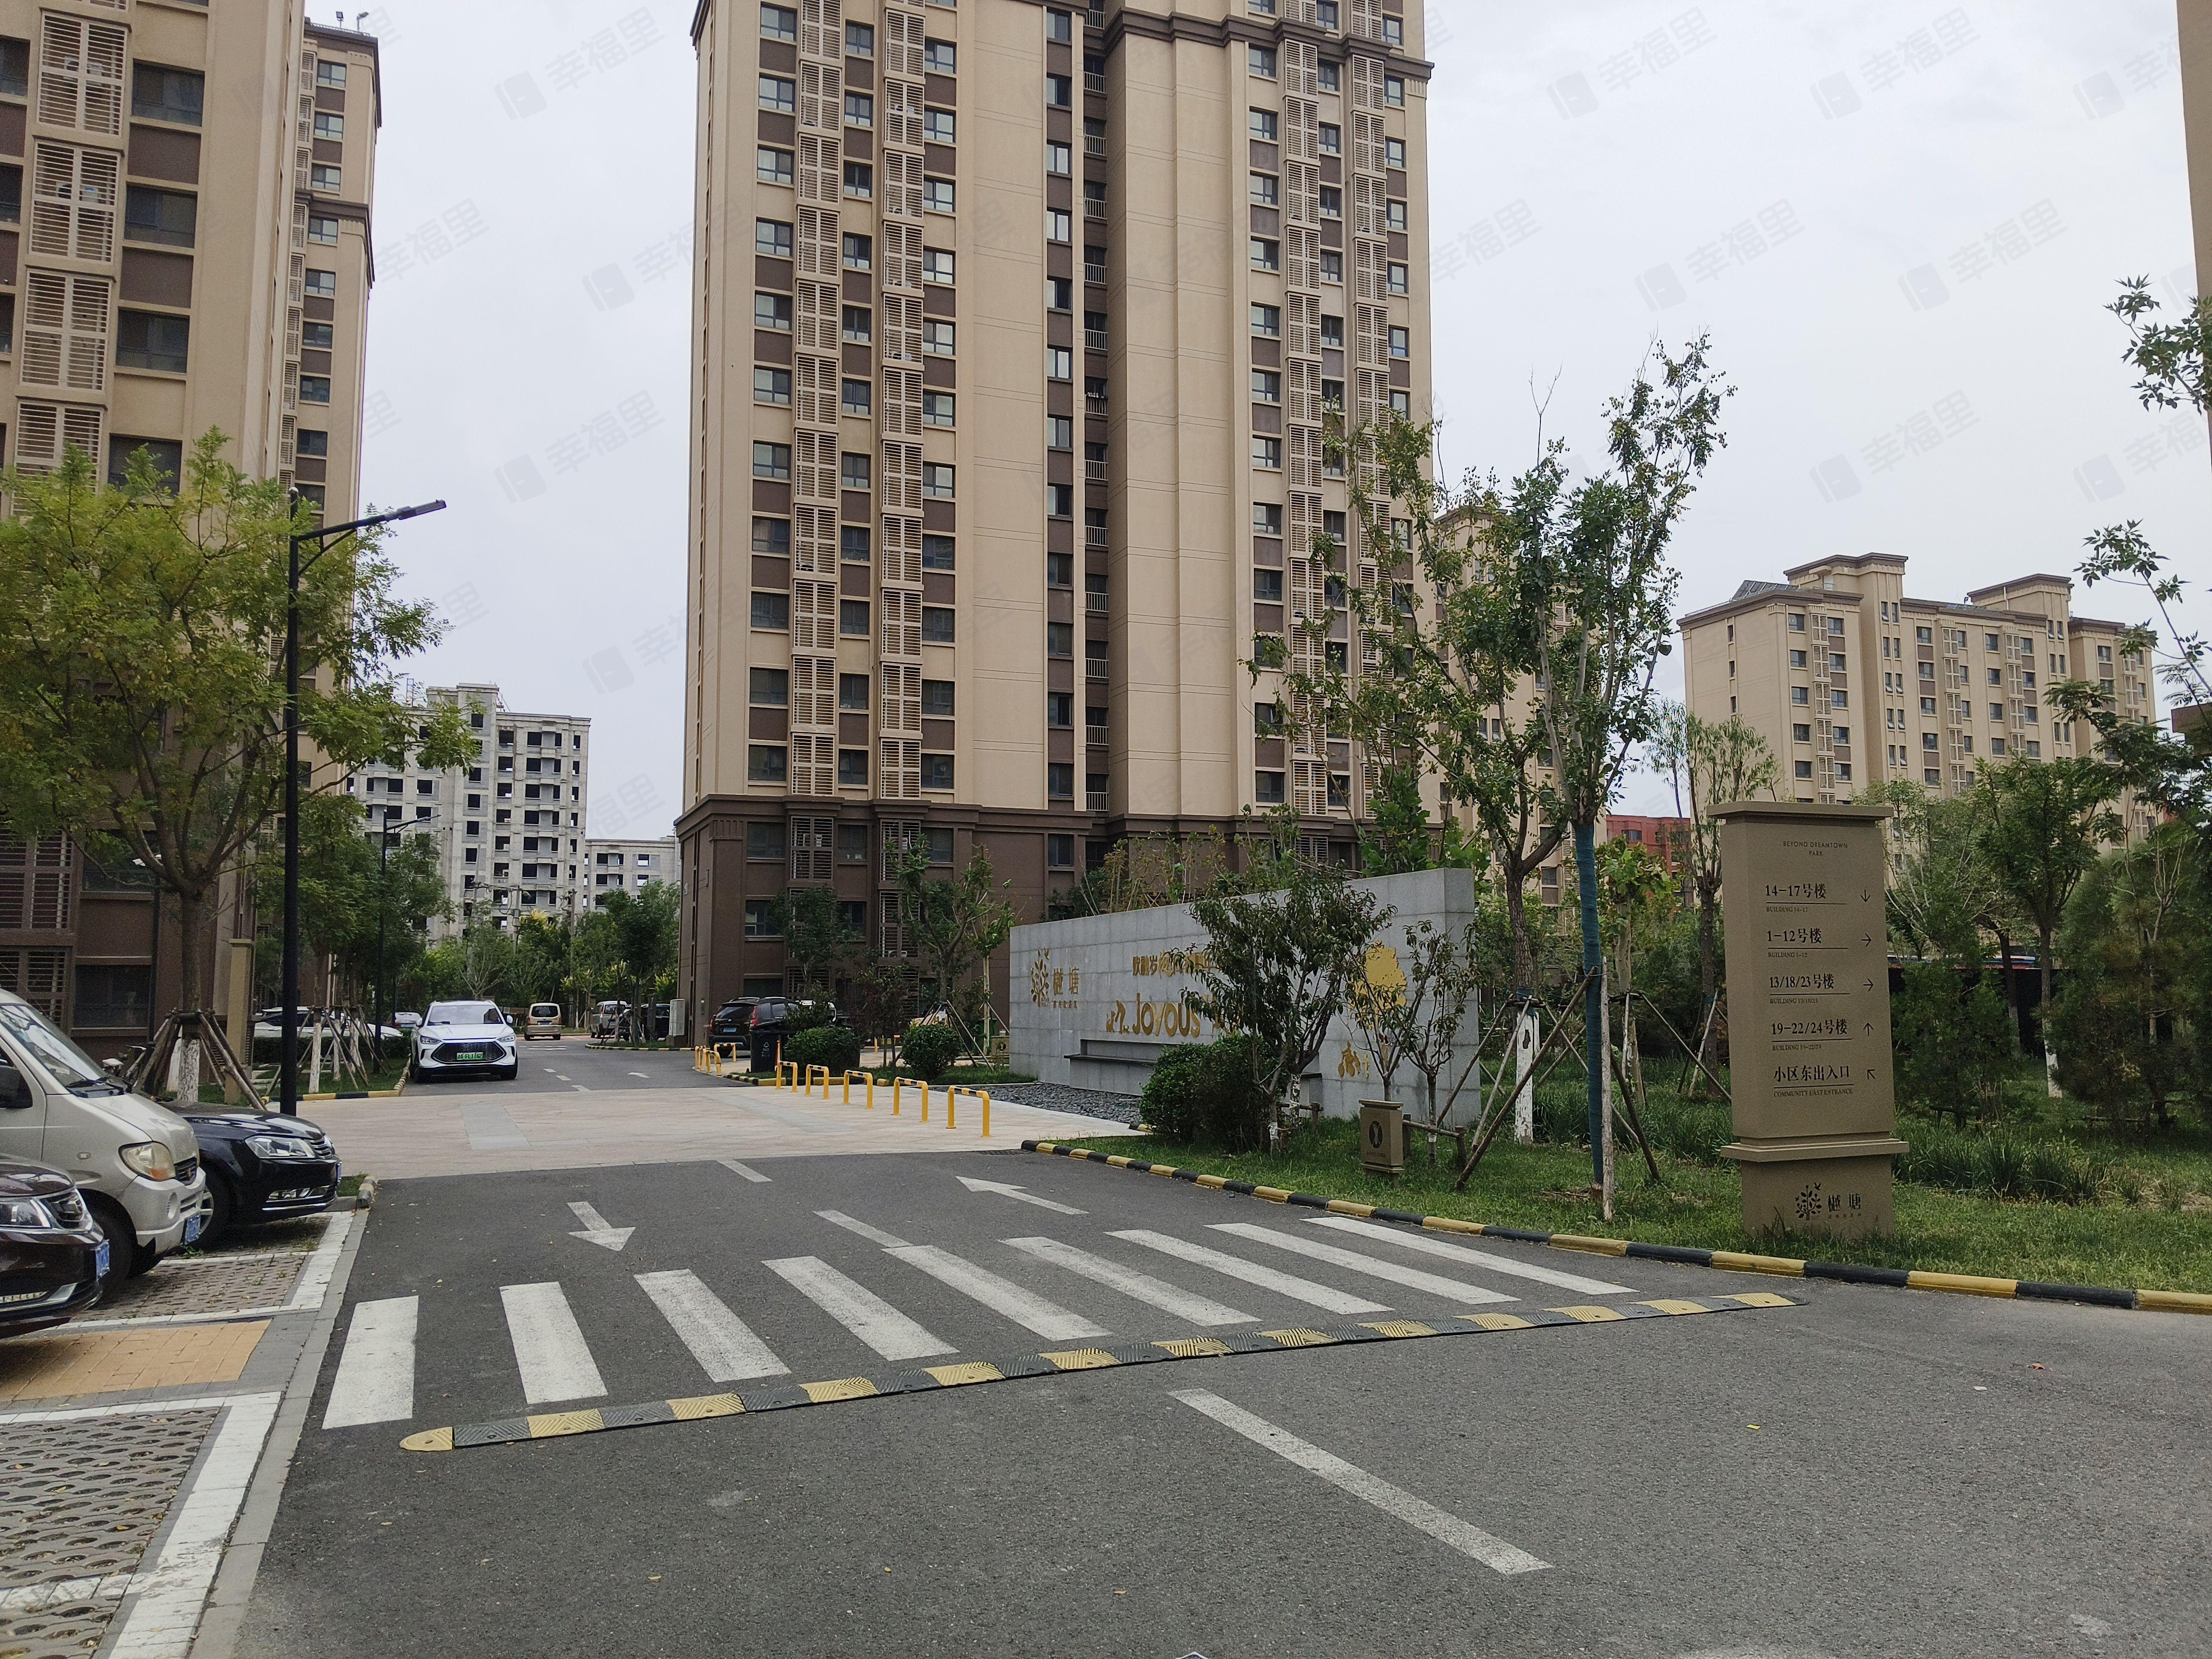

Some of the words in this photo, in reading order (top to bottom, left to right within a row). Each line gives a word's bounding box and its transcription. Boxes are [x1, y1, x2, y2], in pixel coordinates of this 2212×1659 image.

[1765, 883, 1826, 899] 14-17号楼
[1767, 927, 1822, 944] 1-12号楼
[1770, 973, 1834, 989] 13/18/23号楼
[1771, 1019, 1847, 1035] 19-22/24号楼
[1774, 1065, 1849, 1082] 小区东出入口
